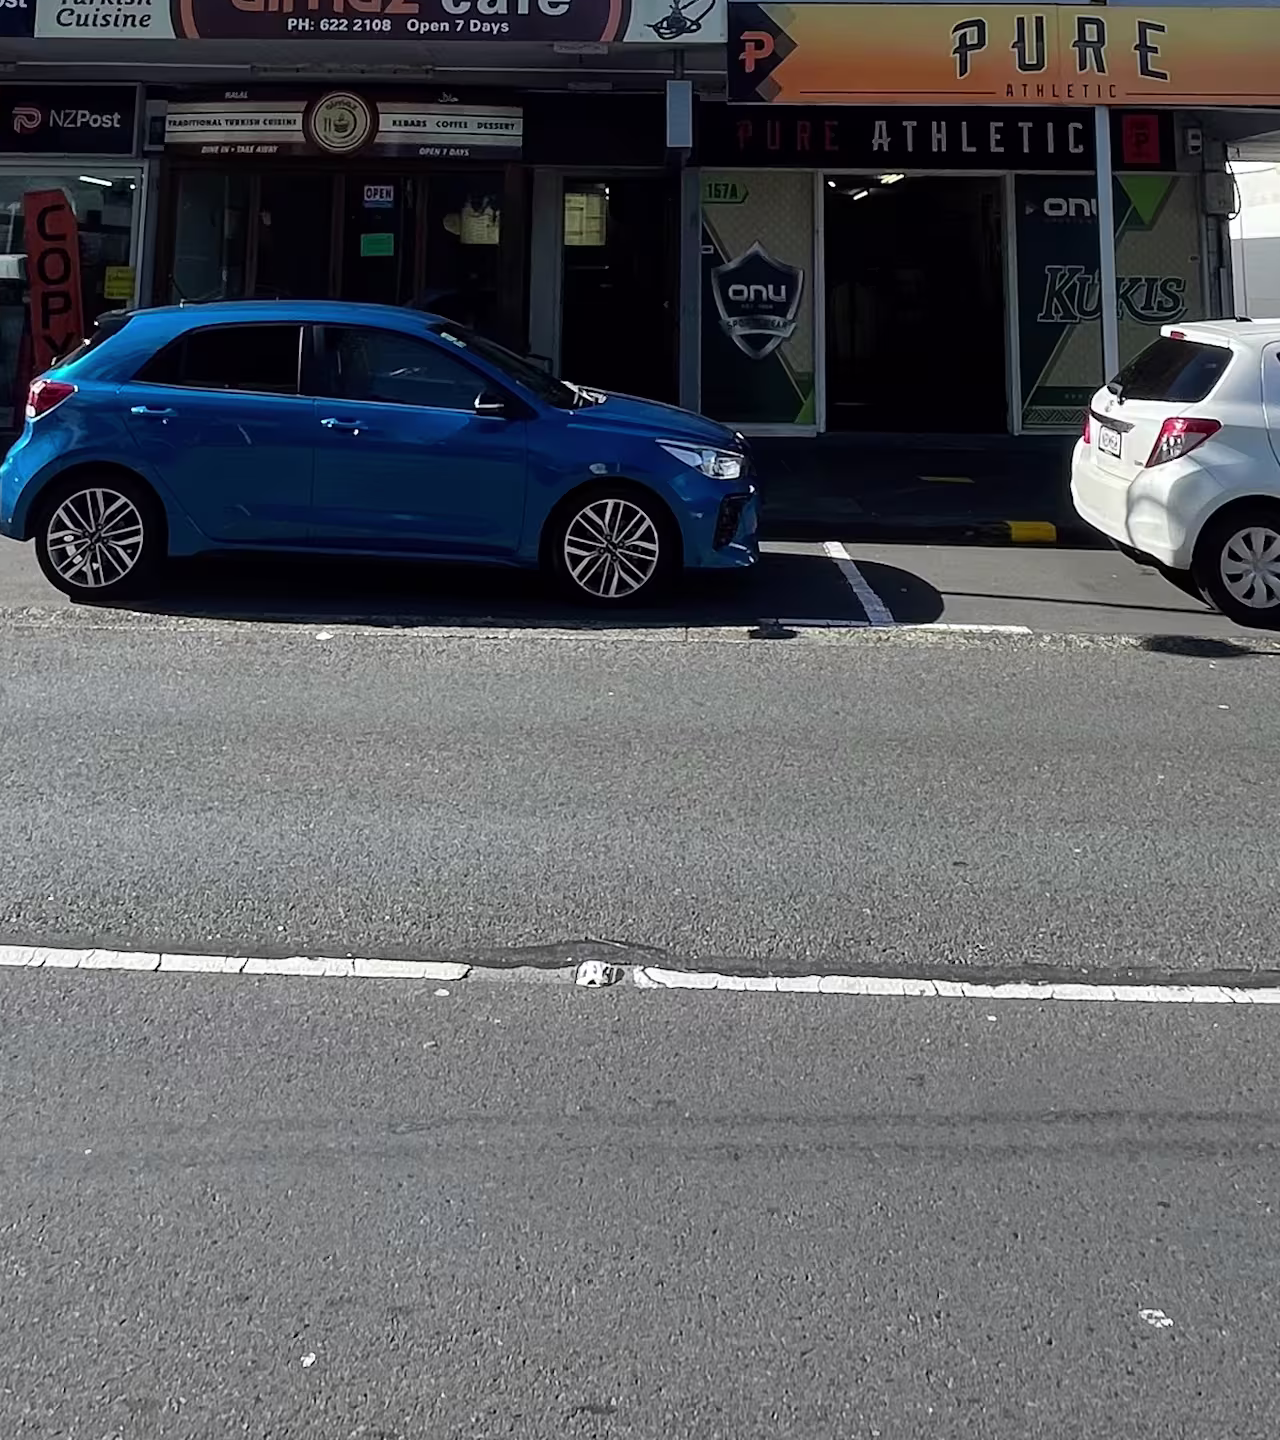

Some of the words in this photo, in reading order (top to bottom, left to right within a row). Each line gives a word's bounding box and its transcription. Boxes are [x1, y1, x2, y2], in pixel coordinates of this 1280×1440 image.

[55, 8, 153, 28] Cuisine
[287, 18, 315, 32] PH:
[319, 18, 349, 32] 622
[352, 18, 392, 33] 2108
[406, 19, 450, 35] Open
[454, 19, 465, 33] 7
[469, 20, 510, 36] Days
[949, 13, 1173, 83] PURE
[1005, 83, 1119, 99] ATHLETIC
[48, 108, 122, 128] NZPost
[476, 121, 516, 131] DESSERT
[735, 119, 840, 153] PURE
[870, 119, 1085, 154] ATHLETIC
[365, 187, 392, 200] OPEN
[35, 203, 76, 359] COPY
